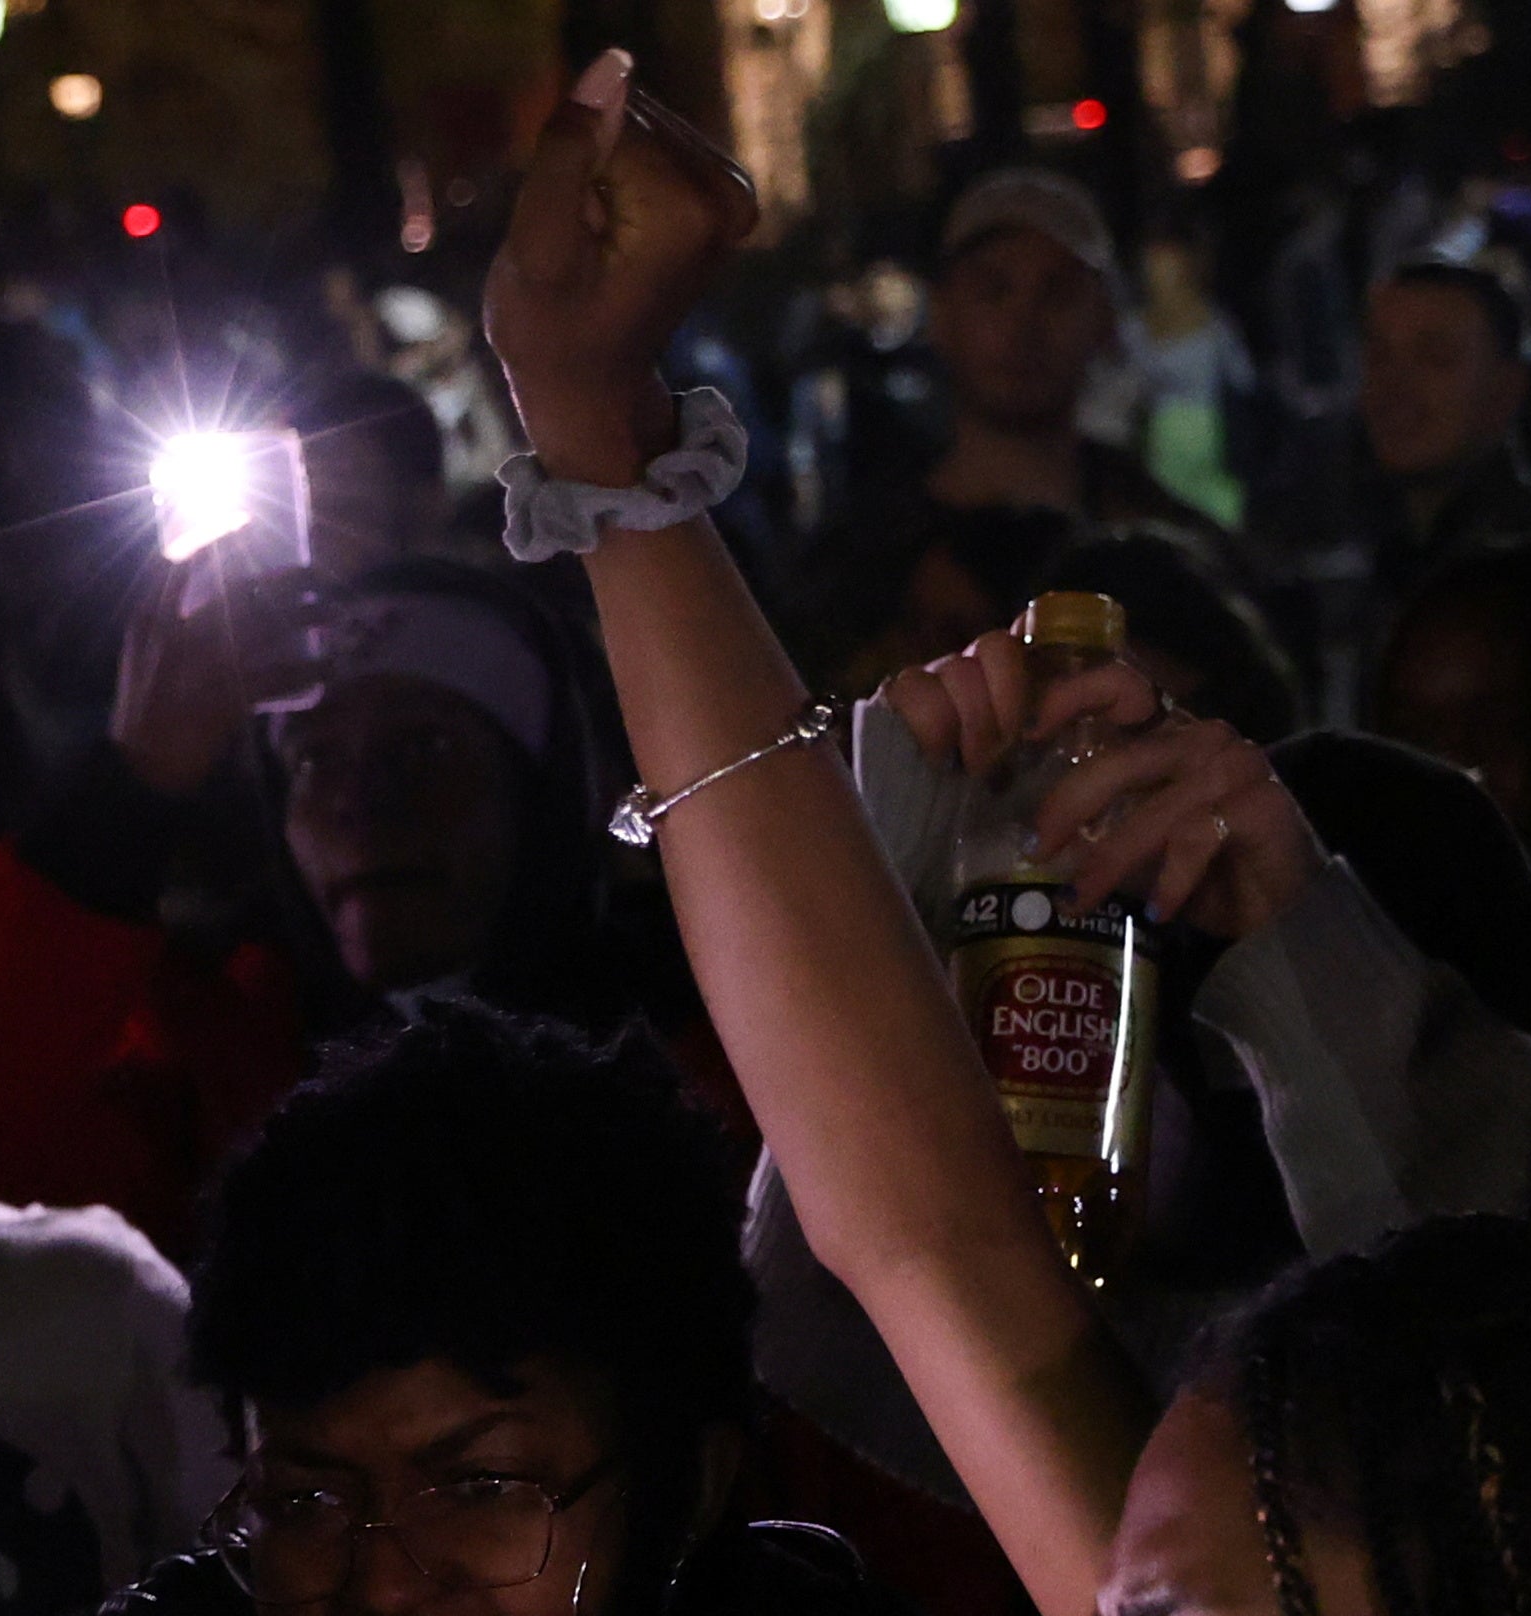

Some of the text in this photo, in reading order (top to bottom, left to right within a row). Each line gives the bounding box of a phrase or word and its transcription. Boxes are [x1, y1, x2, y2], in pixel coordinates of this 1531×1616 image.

[961, 893, 999, 924] 42
[1013, 973, 1104, 1010] OLDE
[992, 1005, 1118, 1046] ENGLISH
